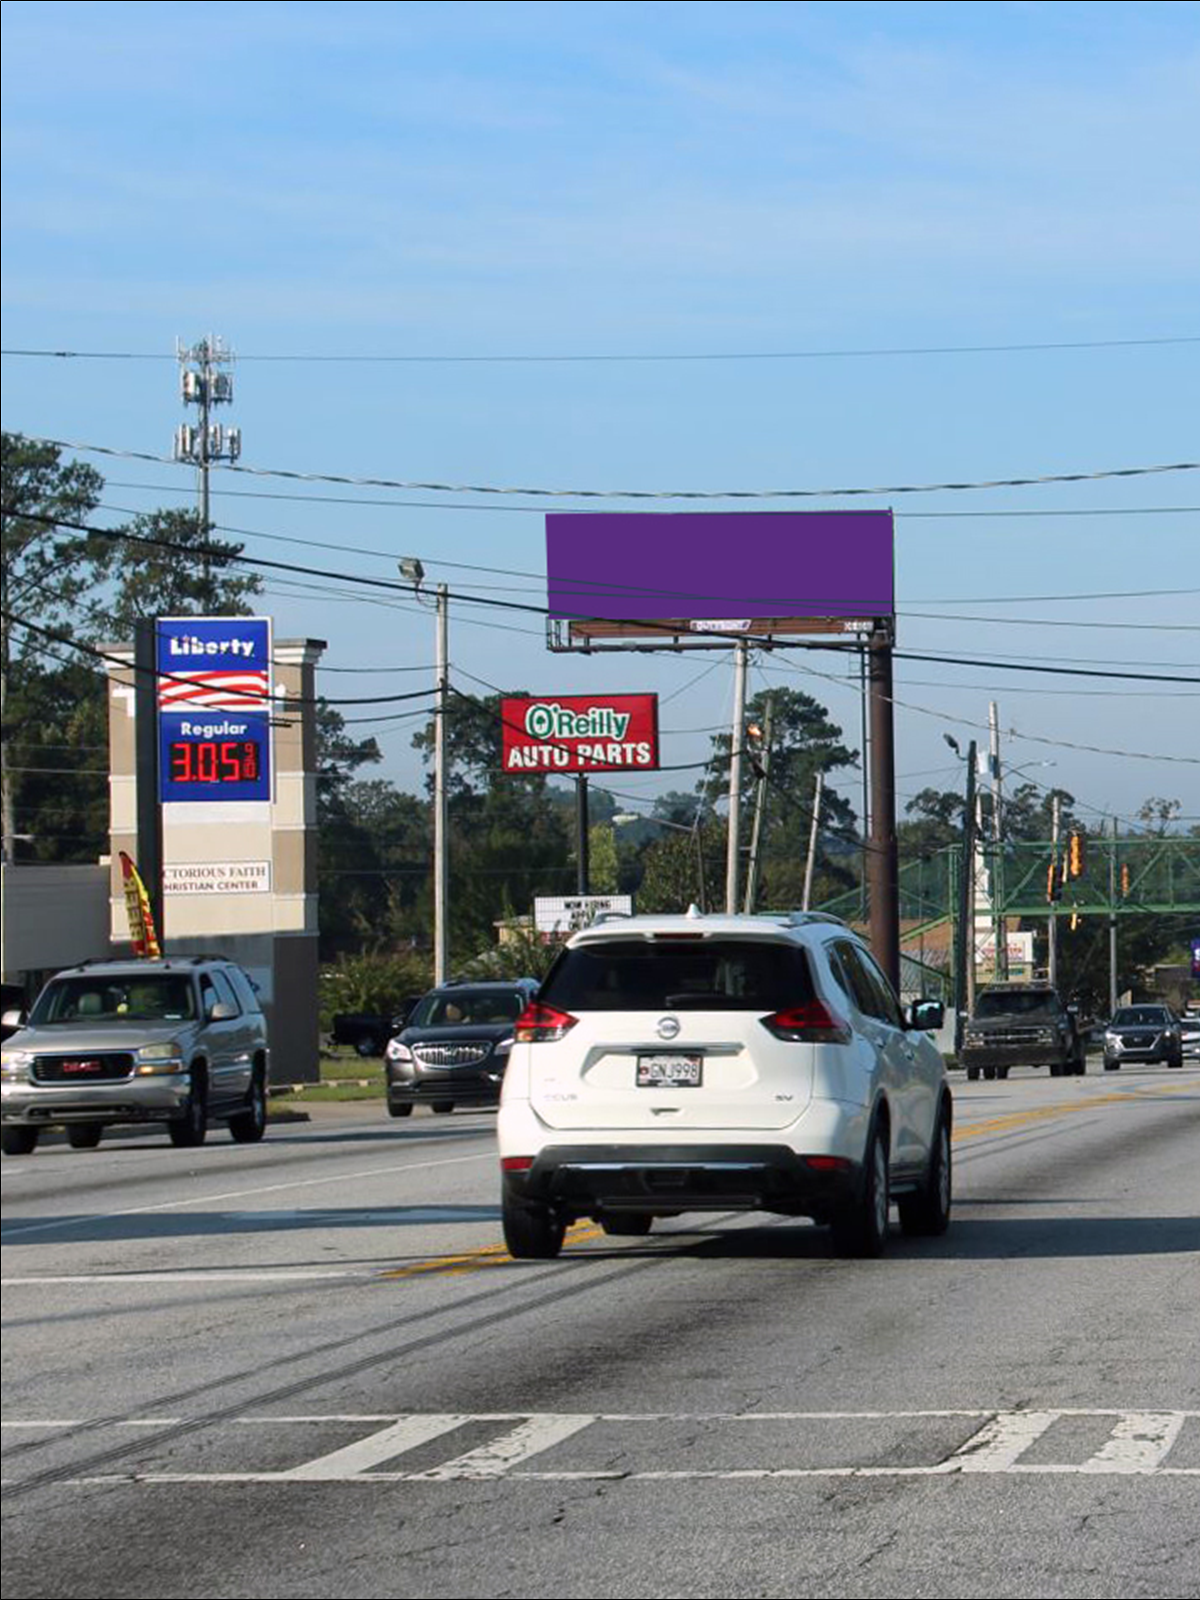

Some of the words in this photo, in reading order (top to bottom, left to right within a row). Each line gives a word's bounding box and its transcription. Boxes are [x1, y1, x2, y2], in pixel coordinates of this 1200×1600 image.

[170, 636, 255, 657] Liberty
[181, 721, 248, 739] Regular
[525, 703, 630, 740] O'Reilly
[173, 742, 241, 782] 3.05
[508, 745, 569, 768] AUTO
[577, 742, 650, 766] PARTS
[163, 866, 226, 879] CTORIOUS
[229, 865, 266, 877] FAITH
[163, 882, 214, 891] HRISTIAN
[216, 881, 259, 890] CENTER
